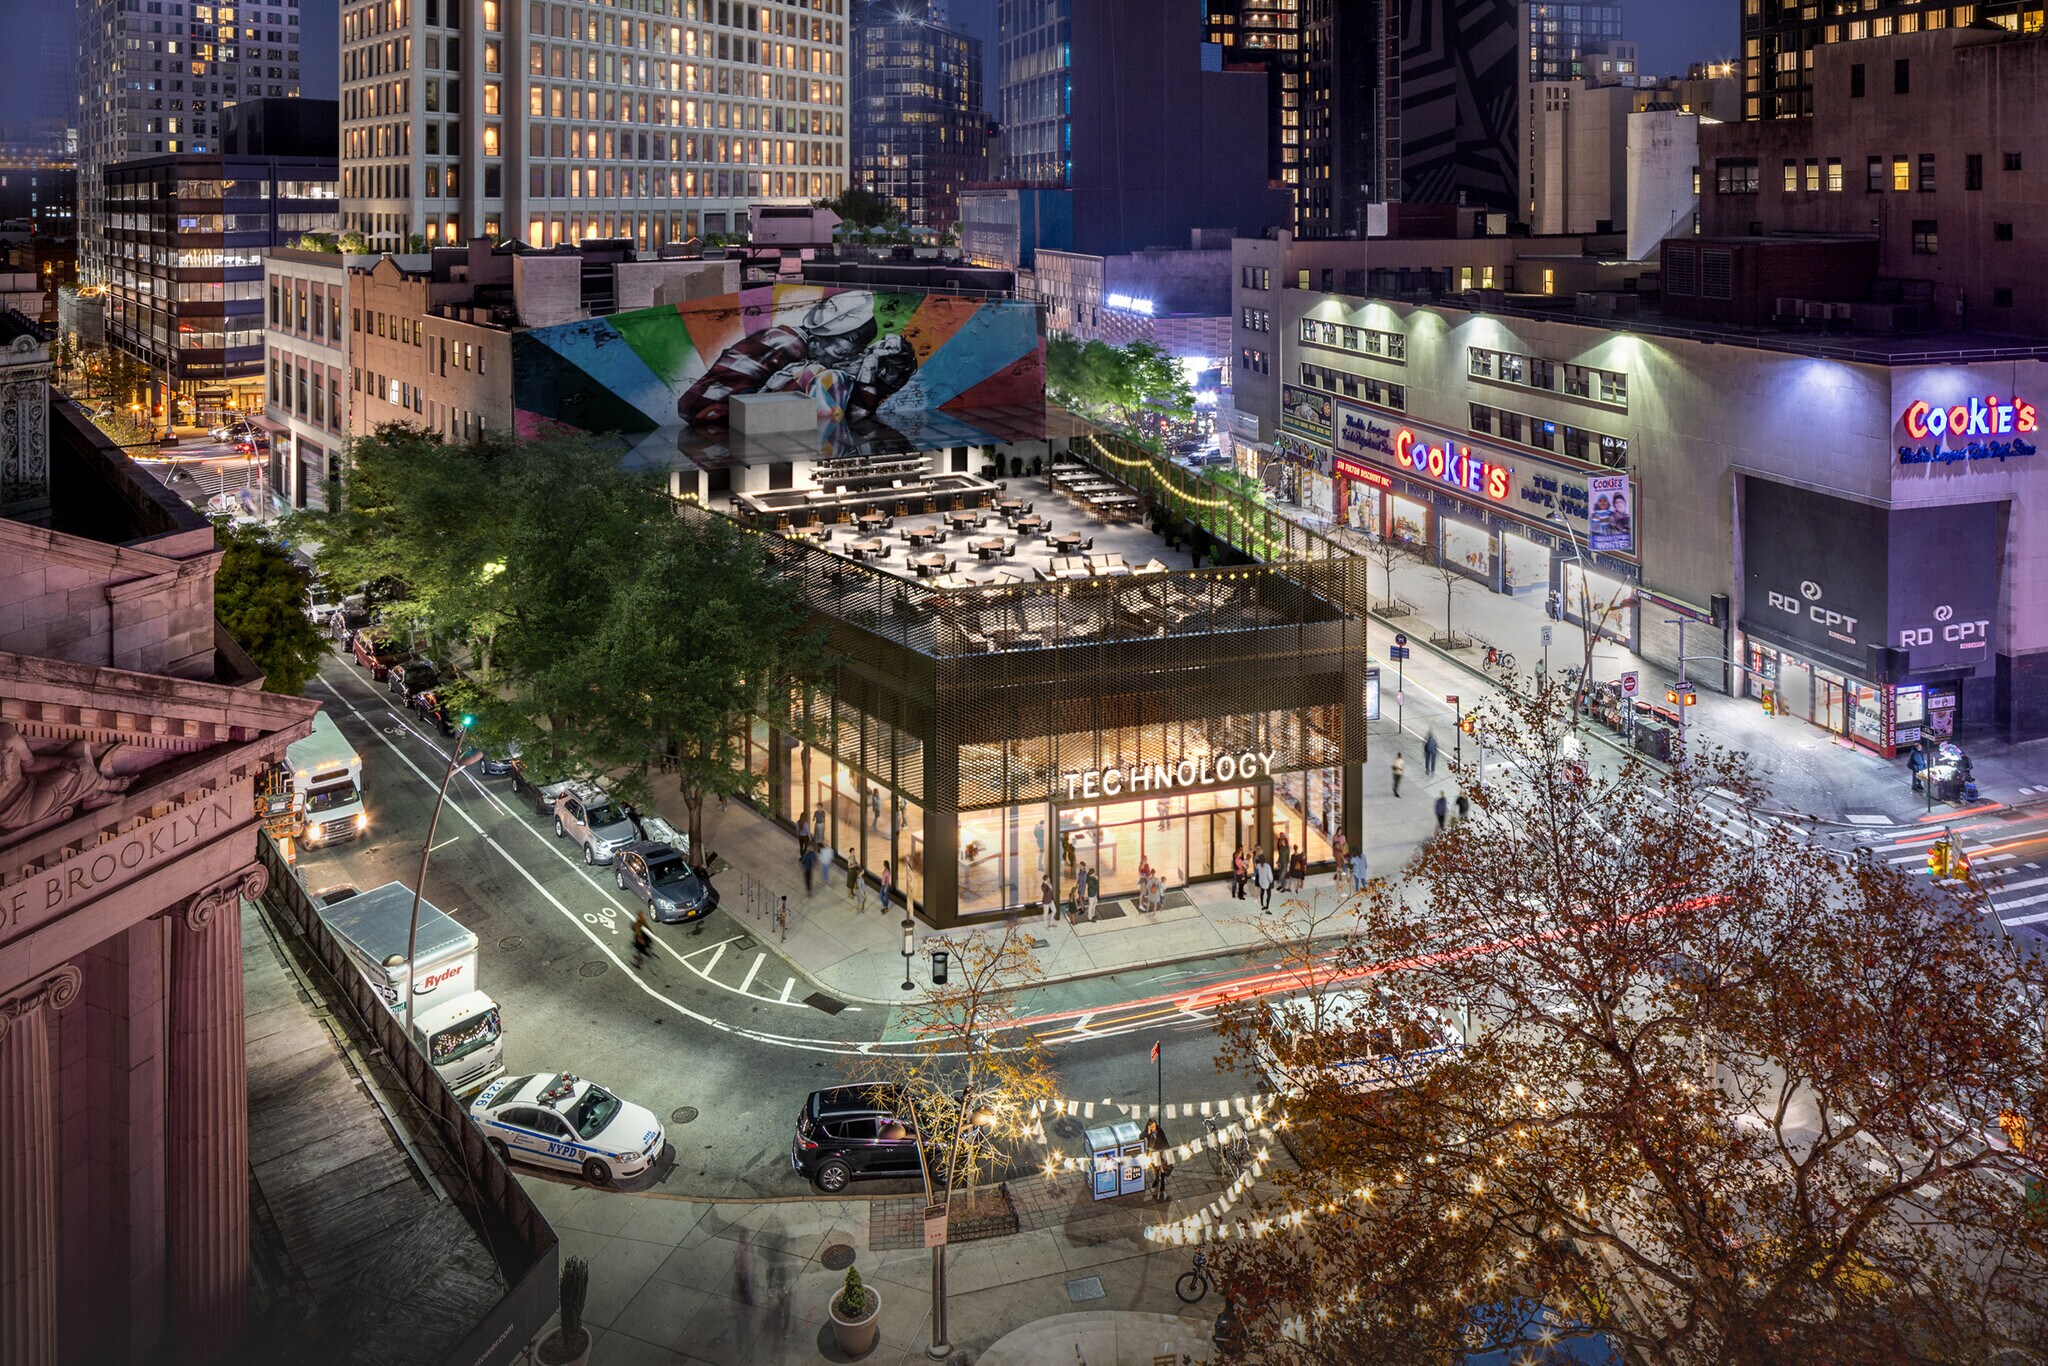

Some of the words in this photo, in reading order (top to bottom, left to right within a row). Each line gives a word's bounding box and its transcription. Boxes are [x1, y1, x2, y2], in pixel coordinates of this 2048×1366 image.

[1360, 468, 1381, 483] DISCOUNT
[1559, 500, 1589, 520] STOR
[1768, 591, 1800, 615] RD
[1810, 605, 1858, 633] CPT
[1901, 627, 1933, 647] RD
[1943, 620, 1989, 642] CPT
[1064, 749, 1277, 800] TECHNOLOGY
[0, 891, 28, 931] F
[45, 795, 234, 910] BROOKLYN
[424, 966, 463, 988] Ryder
[547, 1142, 577, 1158] NYPD
